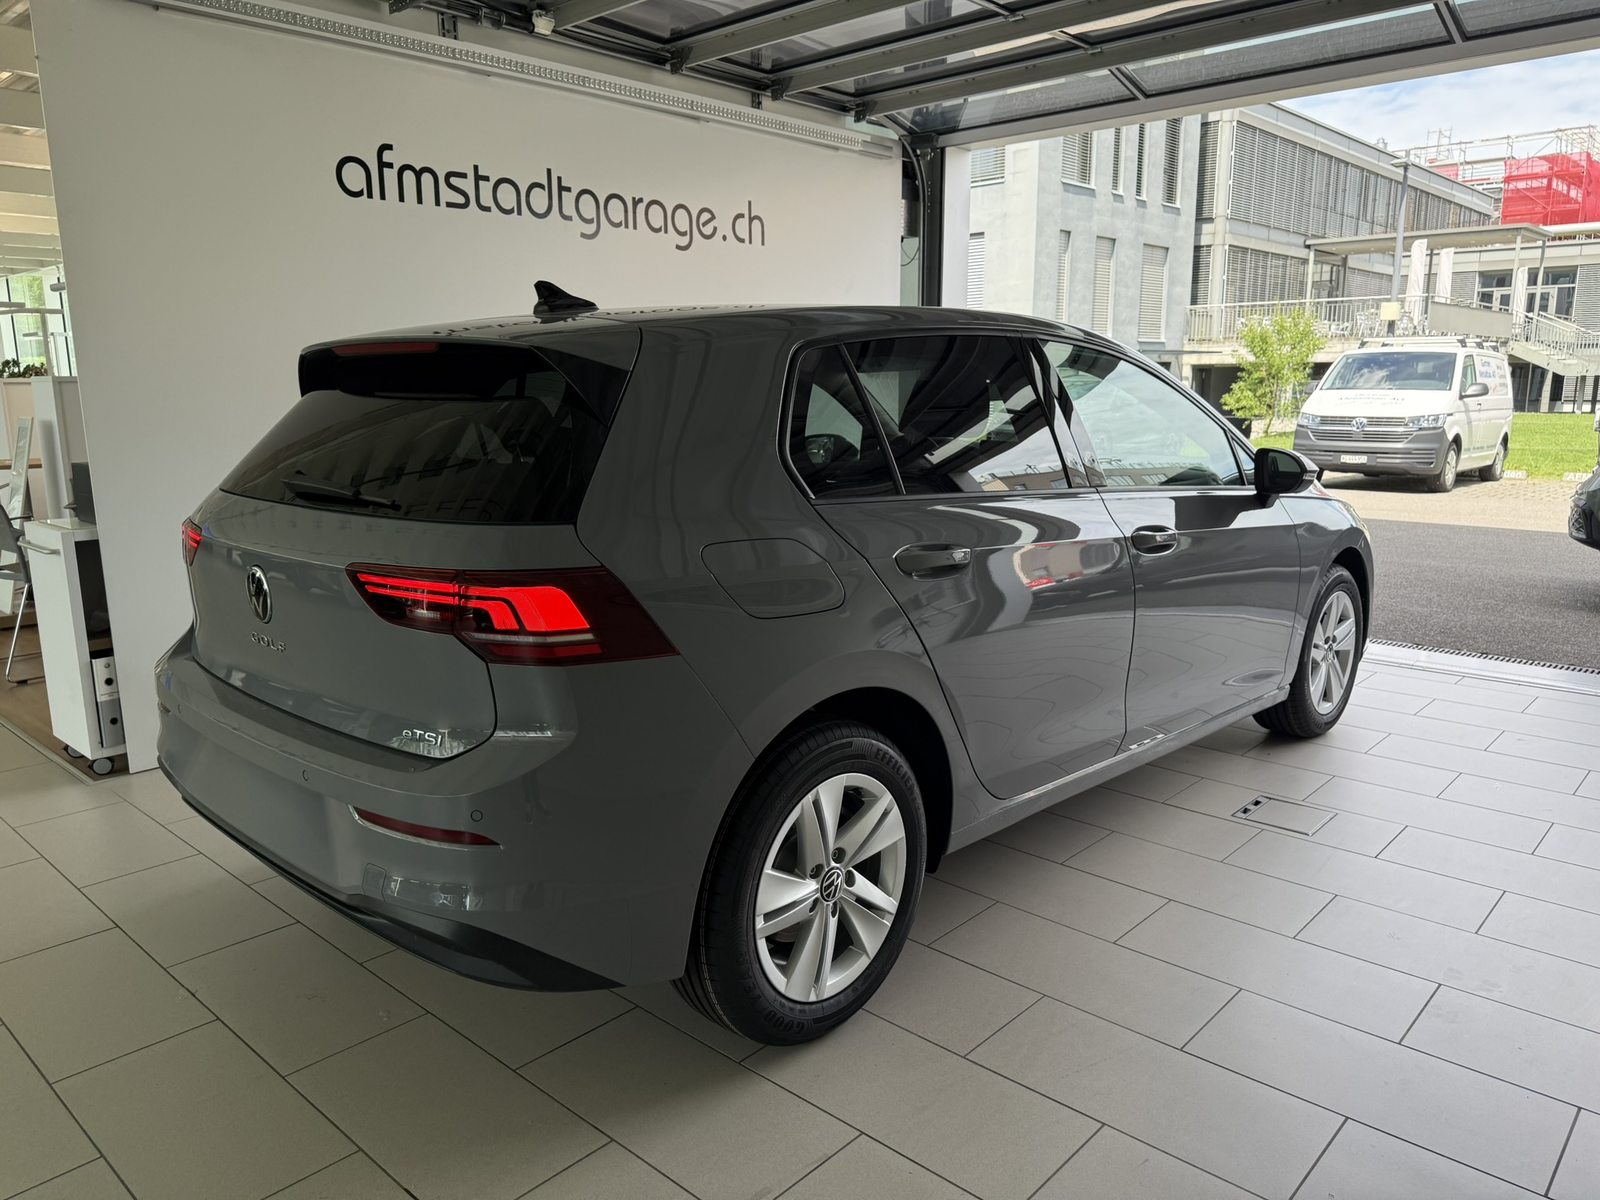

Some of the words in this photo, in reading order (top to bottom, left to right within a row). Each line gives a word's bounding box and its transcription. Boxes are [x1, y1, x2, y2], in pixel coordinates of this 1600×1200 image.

[335, 143, 766, 252] afmstadtgarage.ch
[250, 632, 287, 653] GOLF
[402, 729, 443, 747] eTSI
